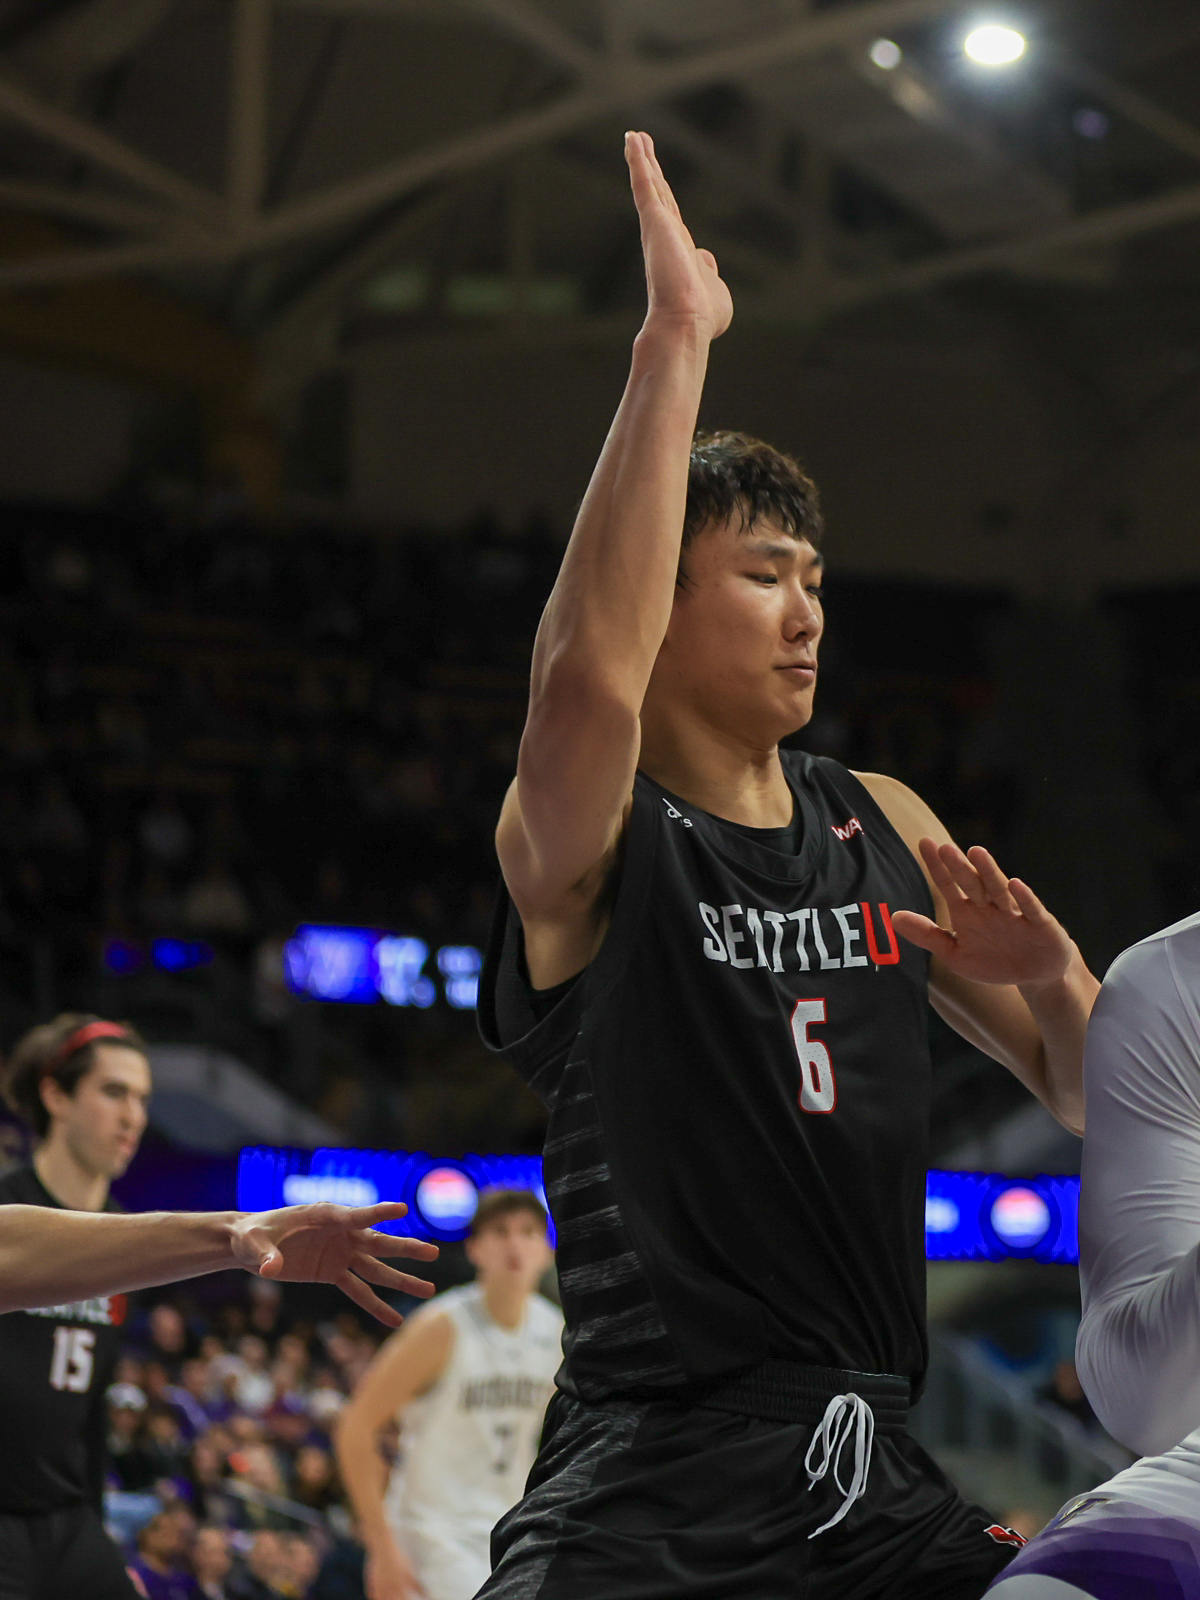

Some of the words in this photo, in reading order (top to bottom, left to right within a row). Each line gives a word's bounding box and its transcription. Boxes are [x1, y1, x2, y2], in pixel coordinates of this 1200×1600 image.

[831, 817, 864, 840] WA
[790, 998, 836, 1113] 6
[50, 1325, 96, 1393] 15
